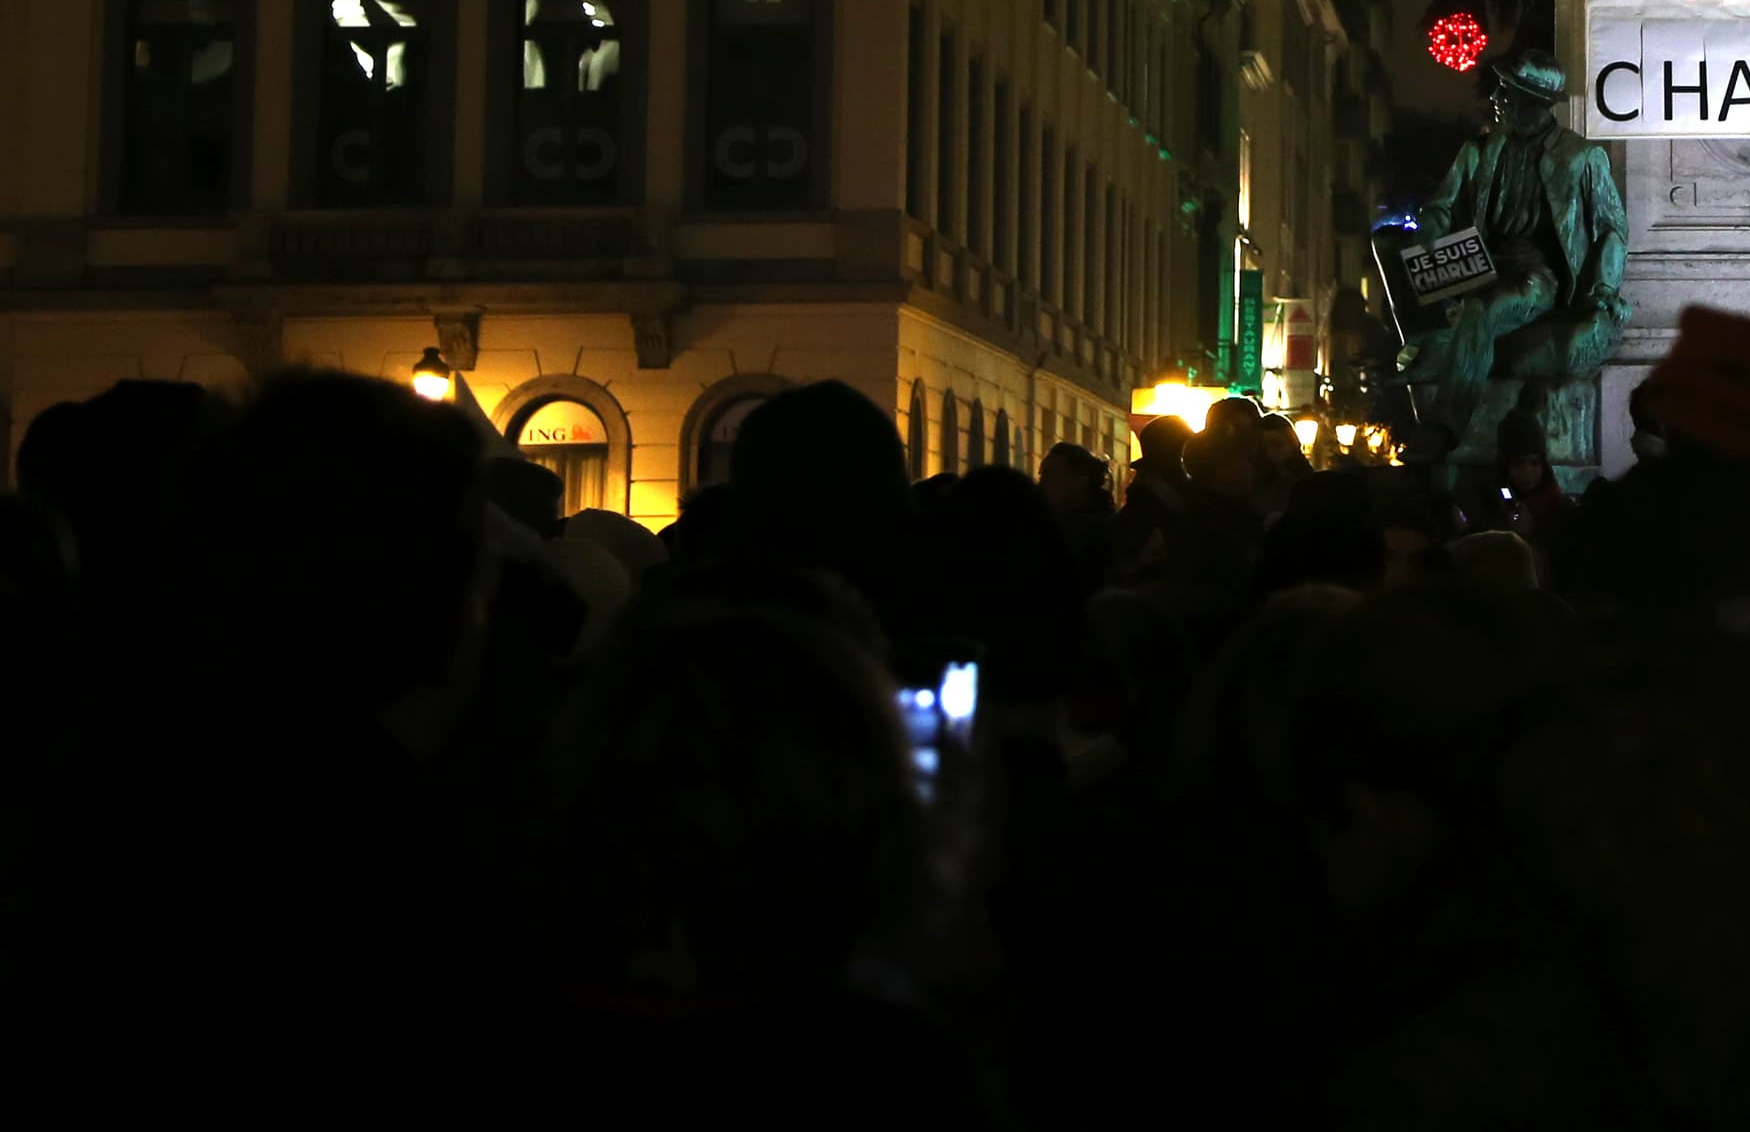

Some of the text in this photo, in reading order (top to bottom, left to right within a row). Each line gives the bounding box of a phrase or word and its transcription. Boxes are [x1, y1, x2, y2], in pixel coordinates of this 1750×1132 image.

[1410, 239, 1480, 273] JE SUIS
[1414, 253, 1489, 290] CHARLIE
[529, 428, 566, 442] ING
